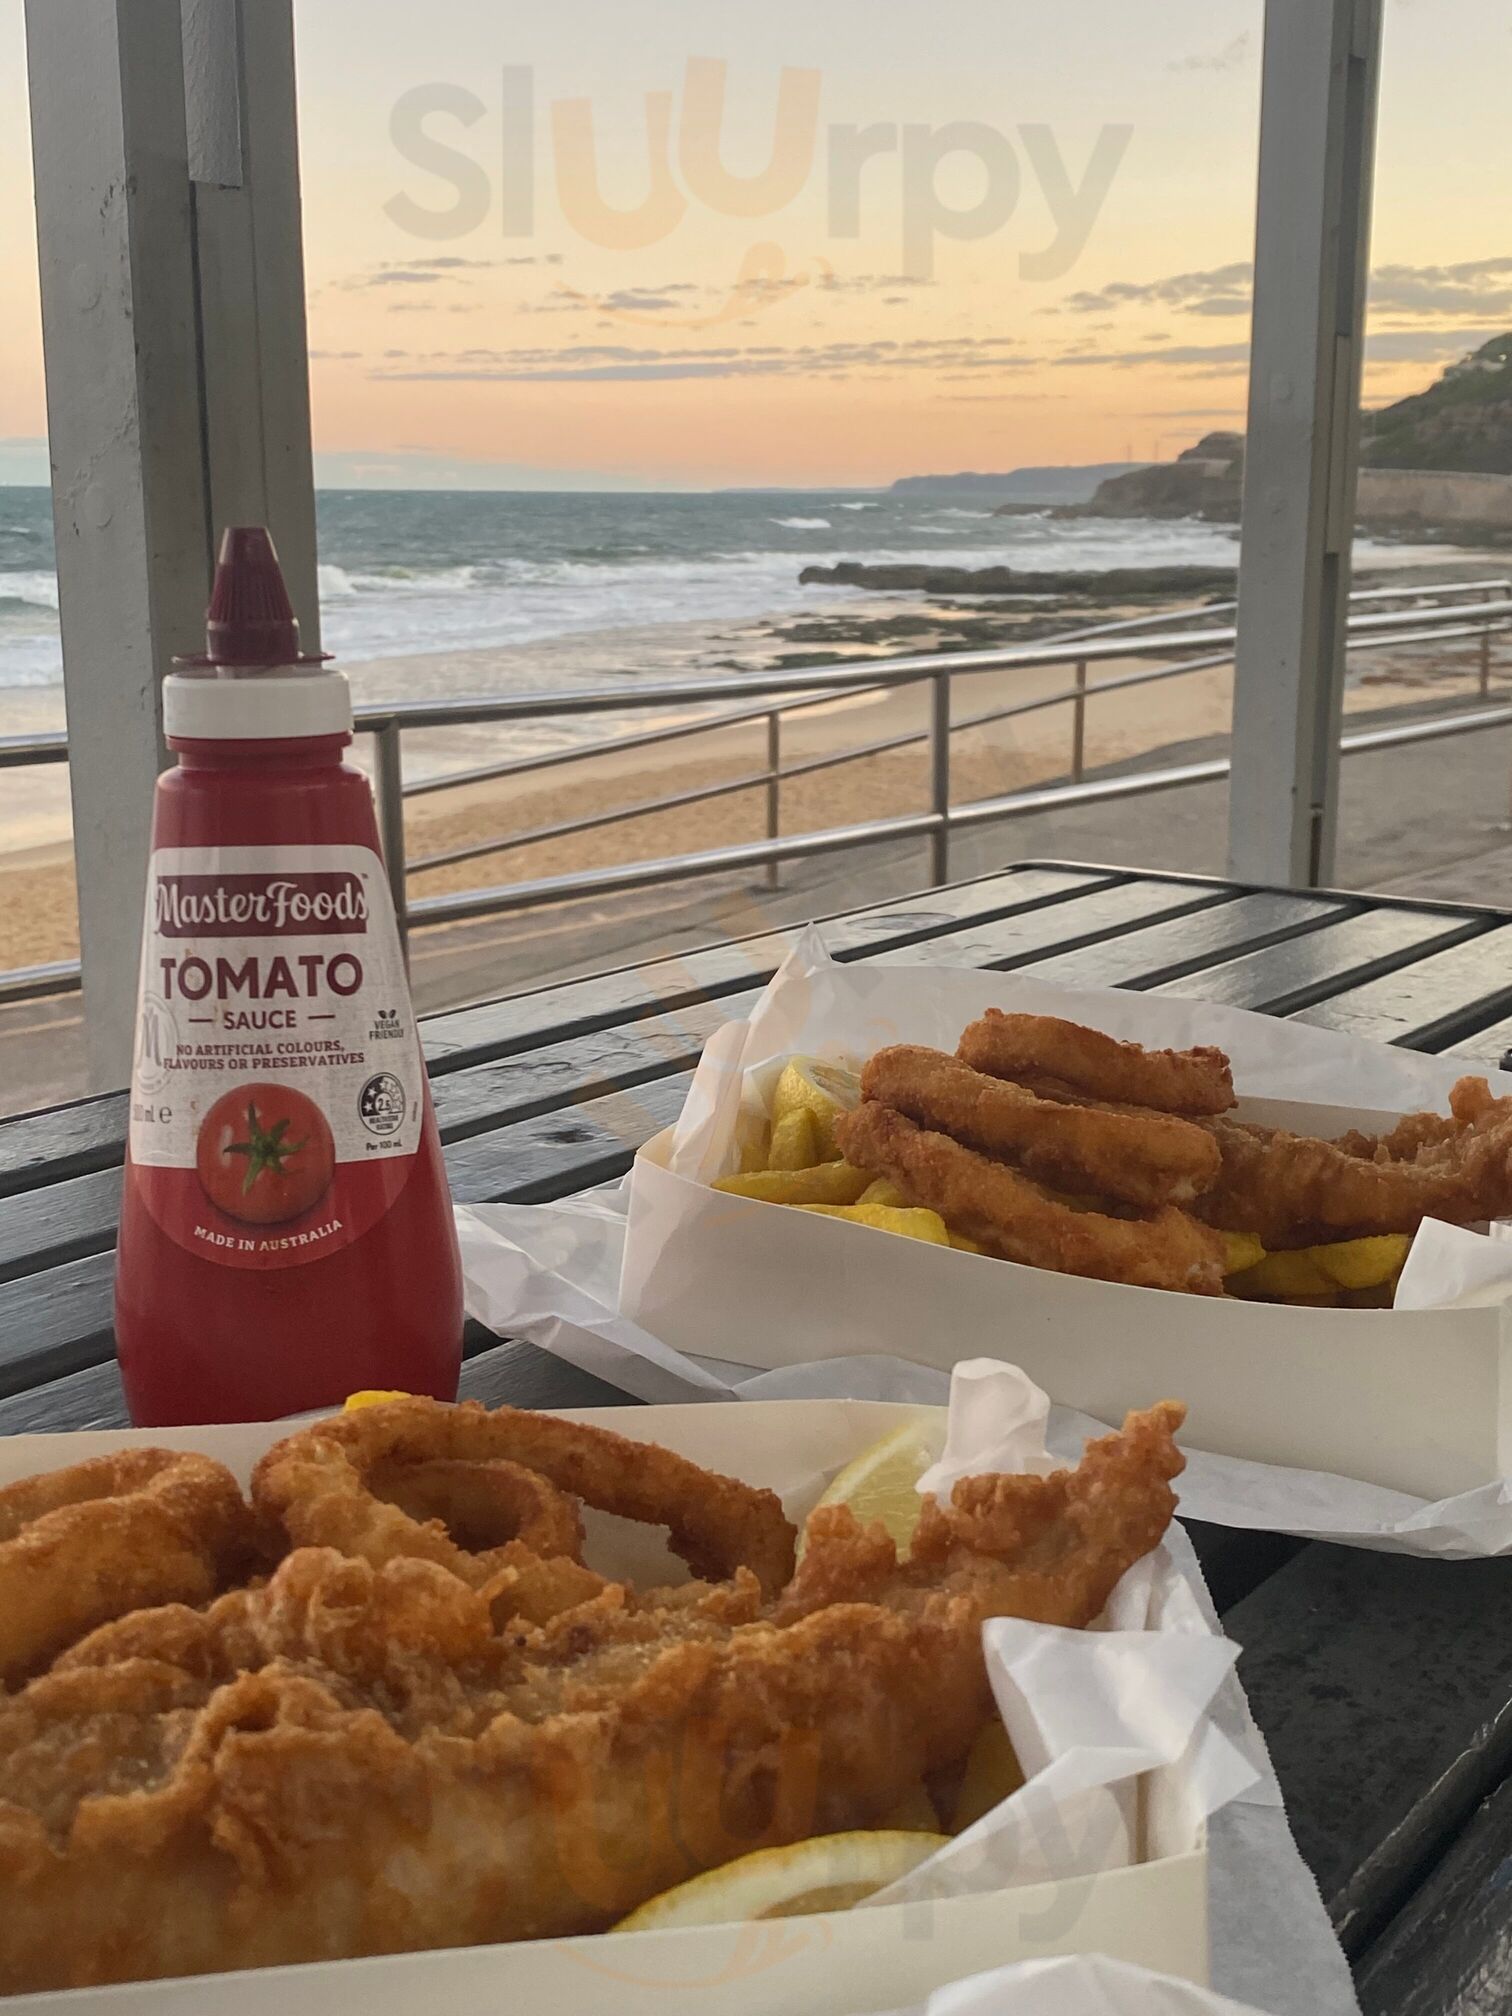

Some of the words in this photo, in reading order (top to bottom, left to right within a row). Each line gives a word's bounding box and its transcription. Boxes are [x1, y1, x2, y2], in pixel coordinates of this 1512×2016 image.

[160, 953, 363, 1001] TOMATO
[223, 1010, 297, 1030] SAUCE
[374, 1020, 400, 1030] VEGAN
[176, 1045, 192, 1056] NO
[195, 1043, 273, 1056] ARTIFICIAL
[163, 1058, 224, 1070] FLAVOURS
[228, 1058, 248, 1070] OR
[252, 1052, 365, 1069] PRESERVATIVES
[194, 1225, 234, 1248] MADE
[238, 1239, 255, 1251] IN
[259, 1219, 343, 1251] AUSTRALIA
